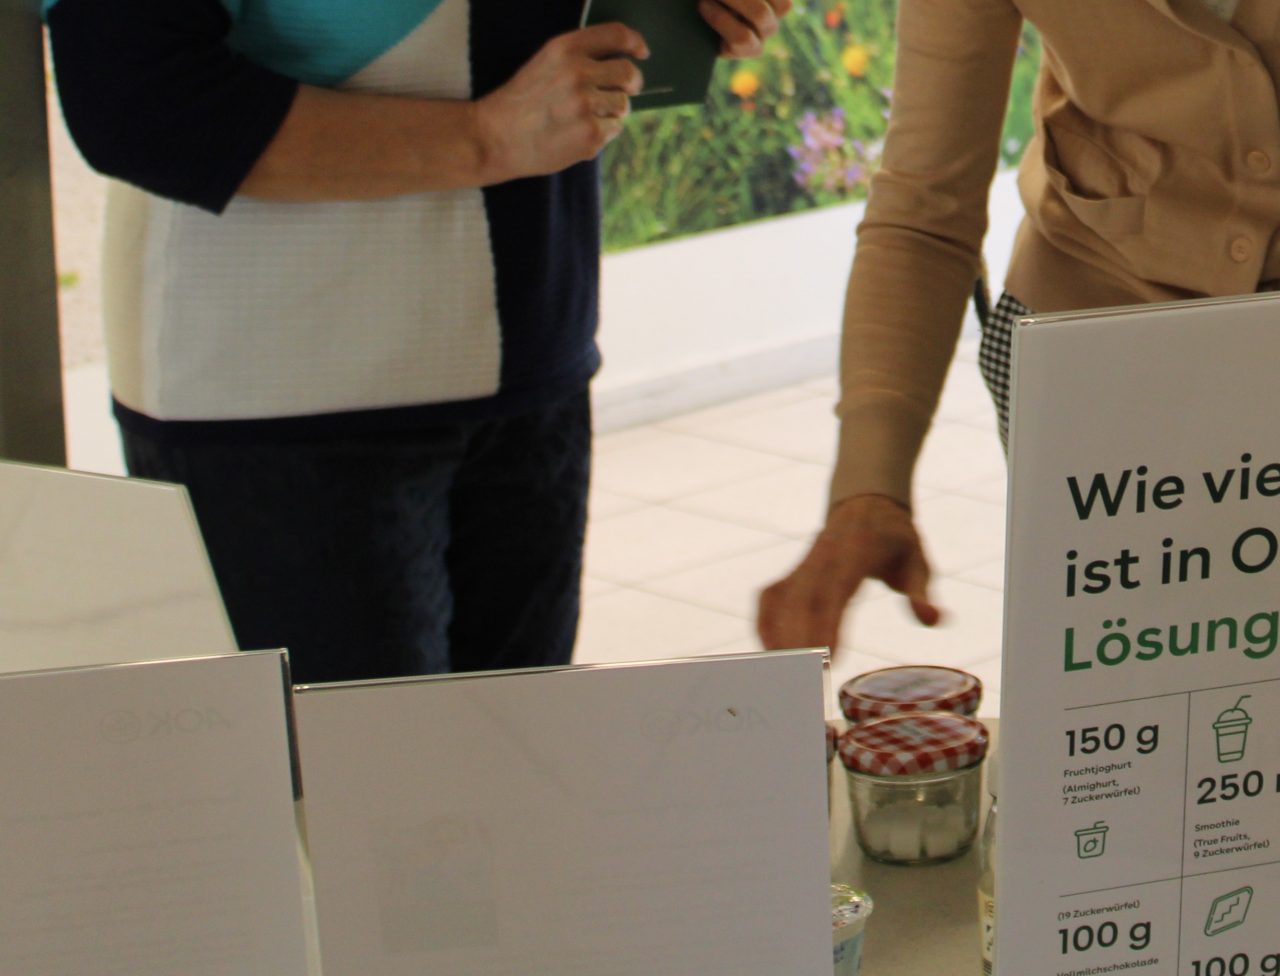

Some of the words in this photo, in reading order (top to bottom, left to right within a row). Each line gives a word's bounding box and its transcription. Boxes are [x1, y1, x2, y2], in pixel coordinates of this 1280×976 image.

[1066, 465, 1186, 521] Wie
[1066, 549, 1141, 597] ist
[1161, 537, 1211, 585] in
[1063, 610, 1280, 672] Lösung
[1065, 723, 1126, 756] 150
[1136, 724, 1159, 754] g
[1063, 761, 1133, 778] Fruchtjoghurt
[1062, 779, 1120, 794] (Almighurt,
[1062, 797, 1069, 805] 7
[1071, 786, 1141, 804] Zuckerwürfel)
[1196, 769, 1264, 805] 250
[1194, 819, 1240, 832] Smoothie
[1193, 839, 1218, 848] (True
[1220, 833, 1251, 843] Fruits,
[1193, 851, 1200, 859] 9
[1202, 840, 1271, 858] Zuckerwürfel)
[1073, 900, 1141, 918] Zuckerwürfel)
[1058, 921, 1119, 955] 100
[1129, 921, 1152, 950] g
[1191, 952, 1250, 976] 100
